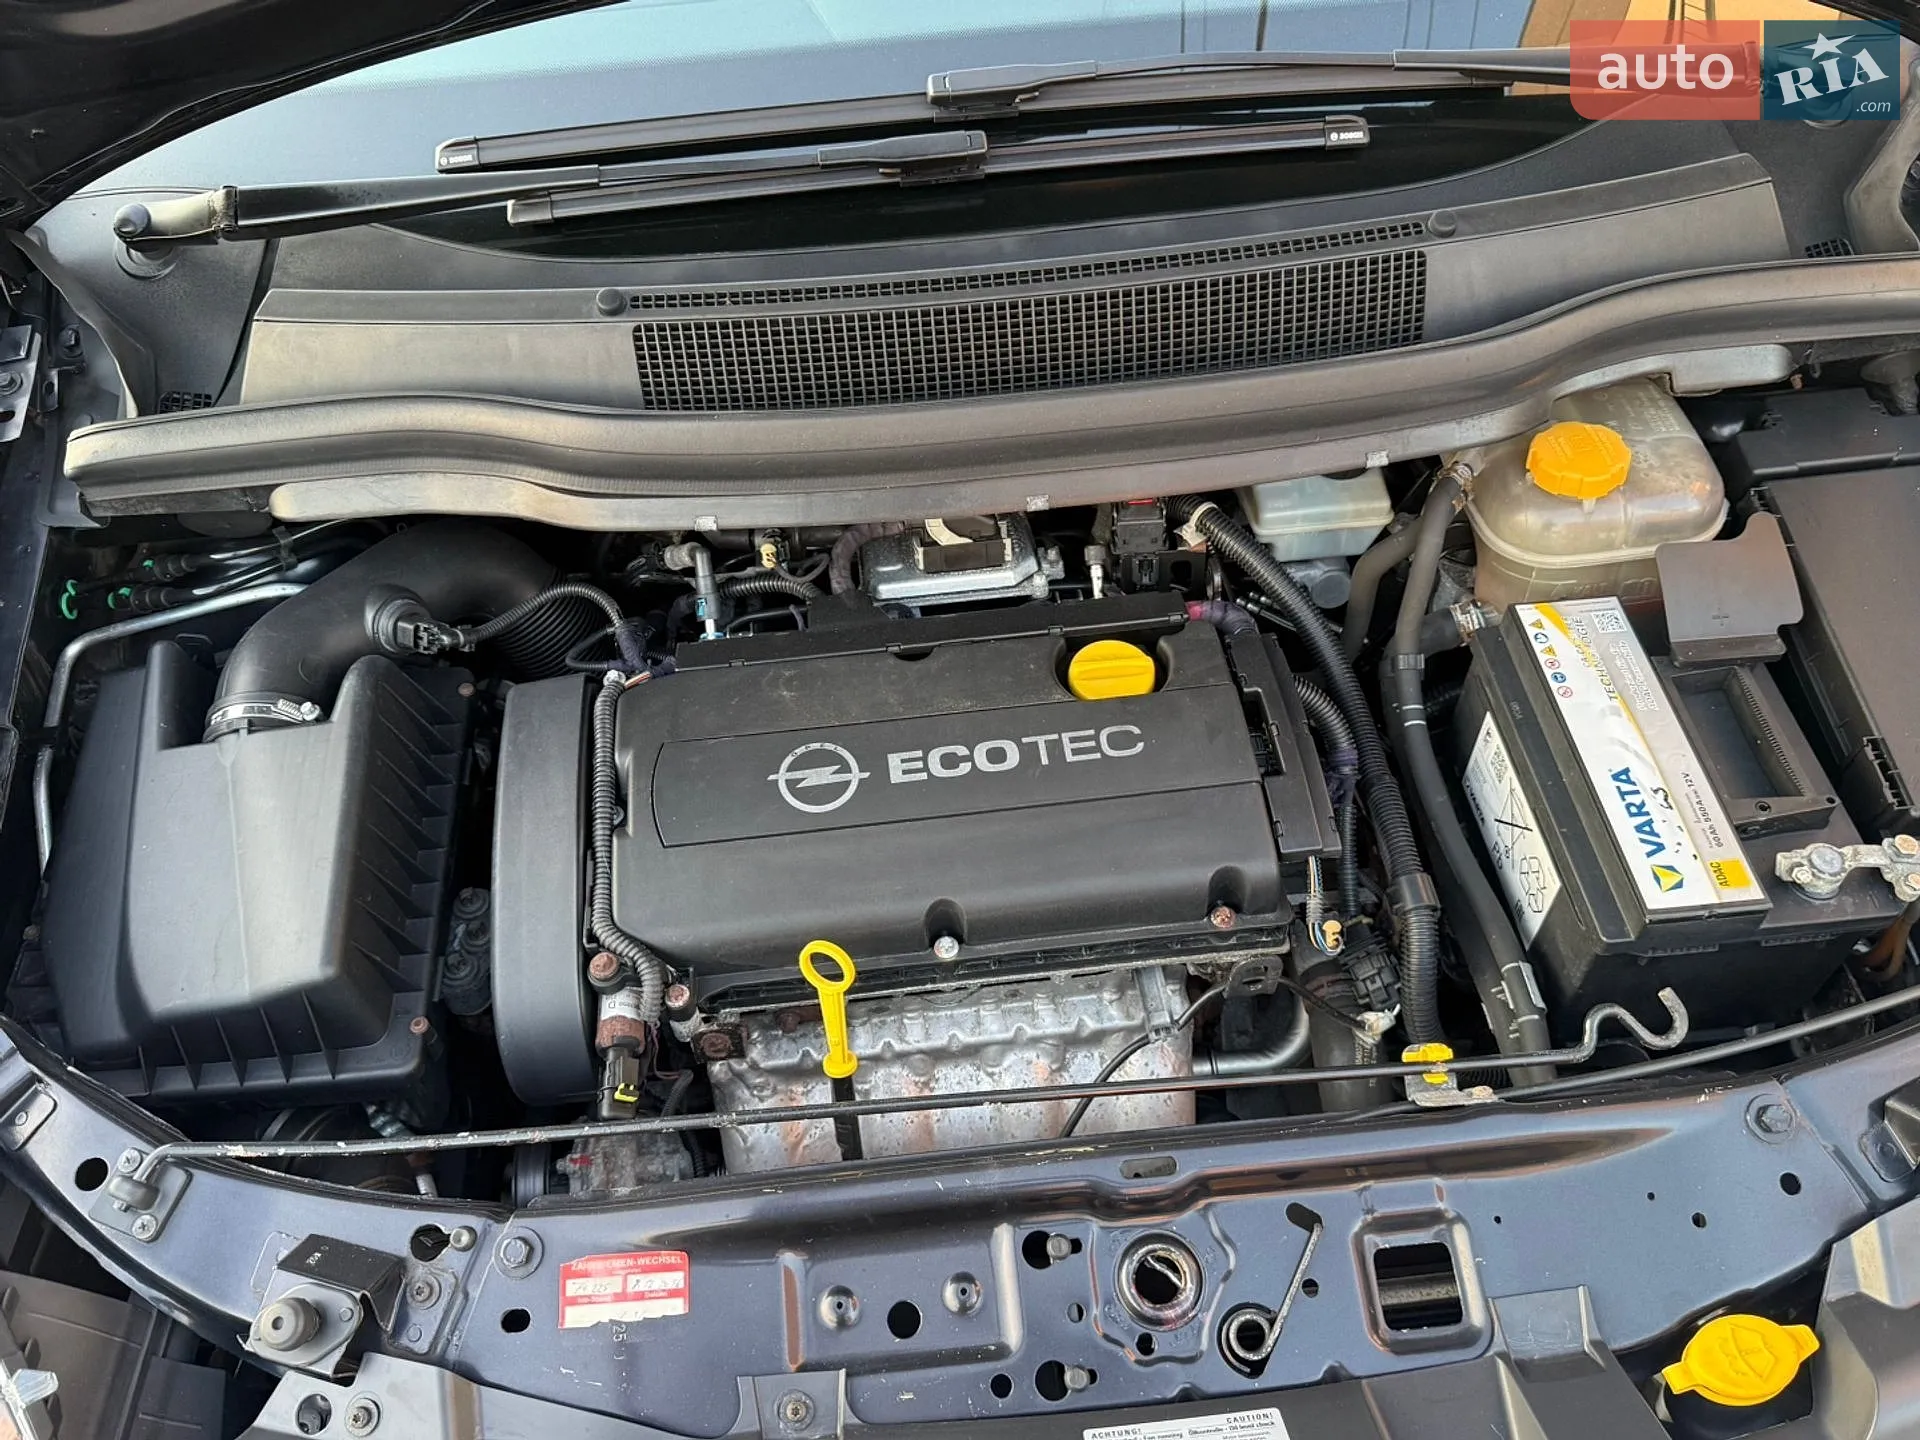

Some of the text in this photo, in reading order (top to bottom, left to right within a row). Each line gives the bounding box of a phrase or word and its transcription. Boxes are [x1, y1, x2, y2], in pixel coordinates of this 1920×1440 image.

[887, 725, 1144, 784] ECOTEC
[1680, 771, 1696, 788] 12V
[1611, 767, 1666, 859] VARTA
[1709, 861, 1730, 887] ADAC
[1226, 1412, 1273, 1424] CAUTION!
[1091, 1428, 1141, 1440] ACHTUNG!
